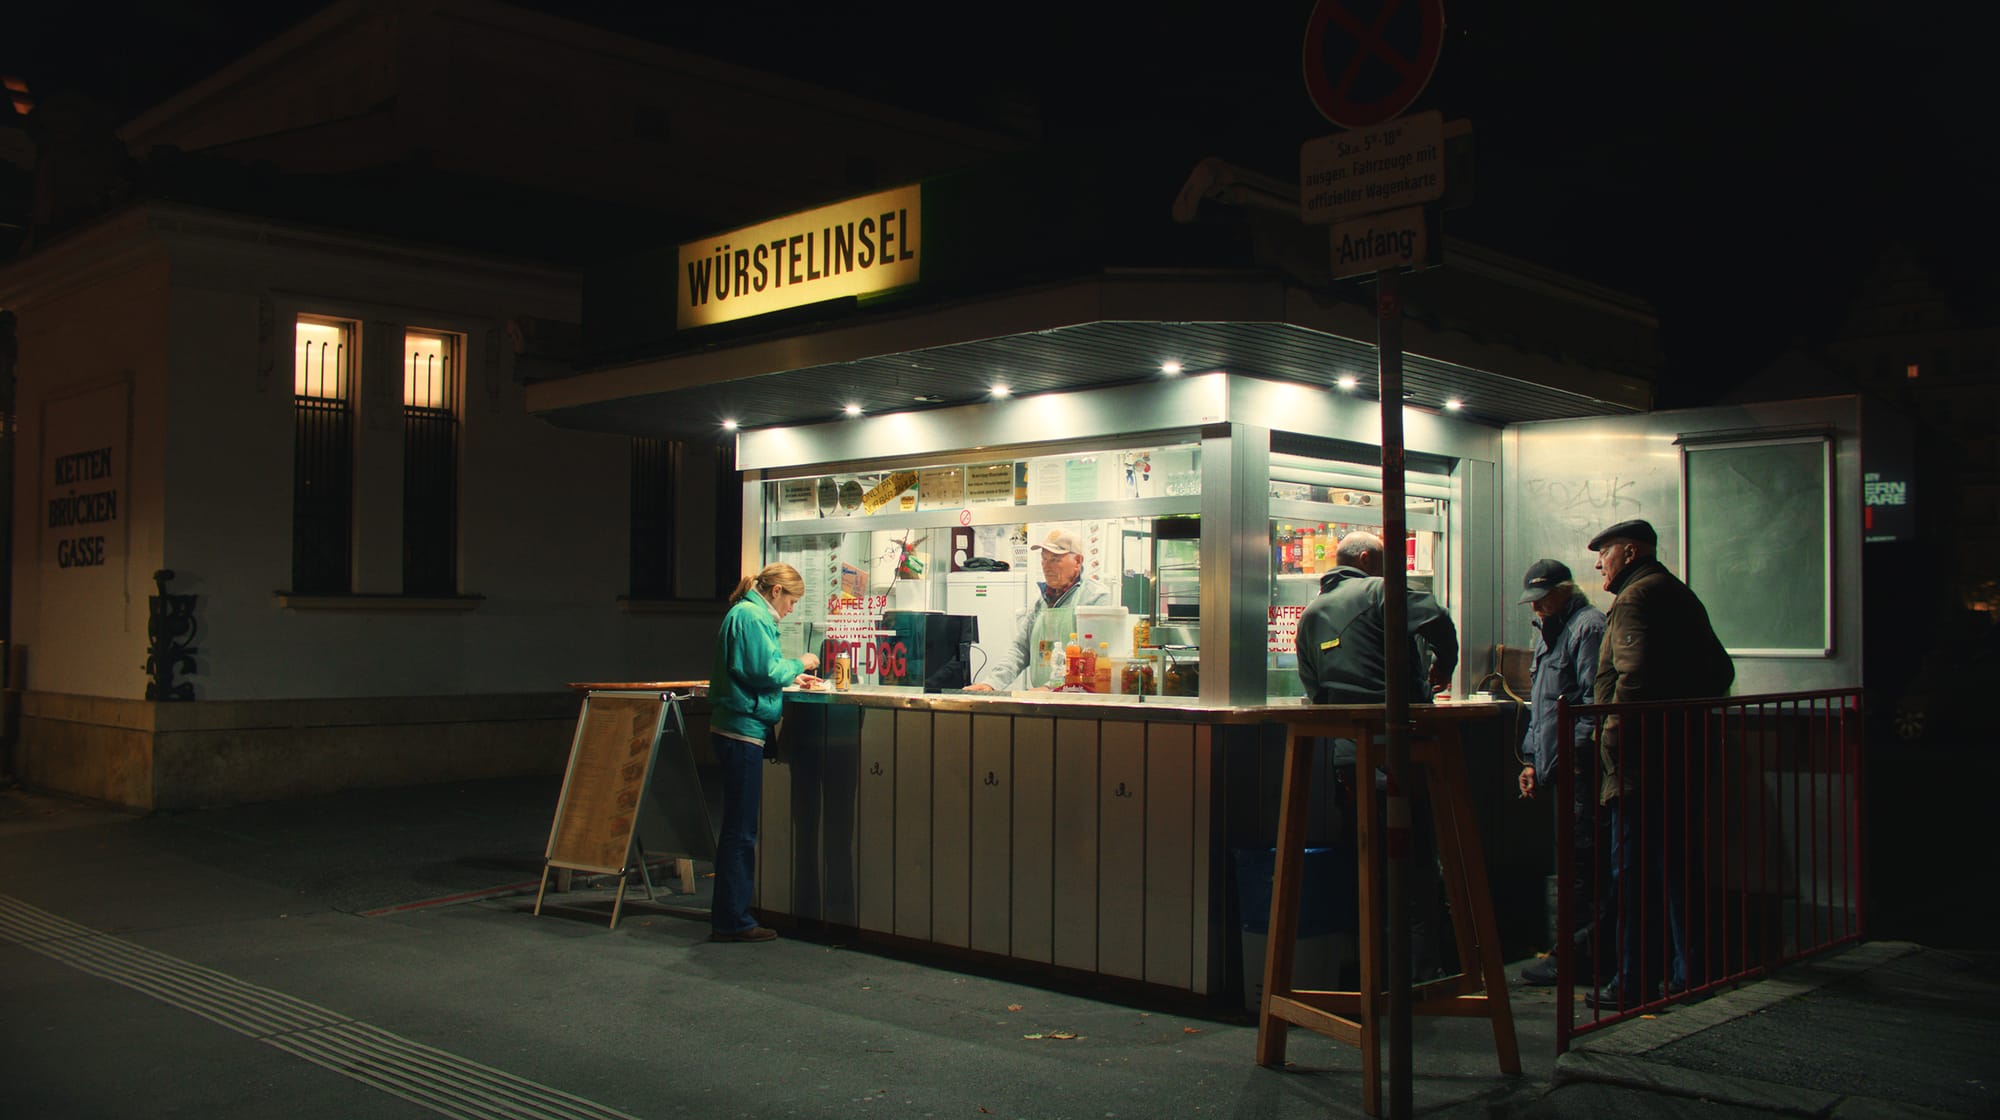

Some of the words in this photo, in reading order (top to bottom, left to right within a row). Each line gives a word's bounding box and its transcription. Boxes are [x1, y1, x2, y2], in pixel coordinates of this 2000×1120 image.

[1352, 152, 1413, 177] Fahrzeuge
[1415, 144, 1438, 161] mit
[1307, 187, 1362, 210] offizieller
[1365, 173, 1437, 199] Wagenkarte
[687, 208, 914, 307] WÜRSTELINSEL
[1339, 227, 1413, 264] Anfang
[54, 446, 113, 486] KETTEN
[47, 488, 117, 528] BRÜCKEN
[57, 535, 105, 568] GASSE
[827, 597, 864, 610] KAFFEE
[866, 641, 906, 677] DOG
